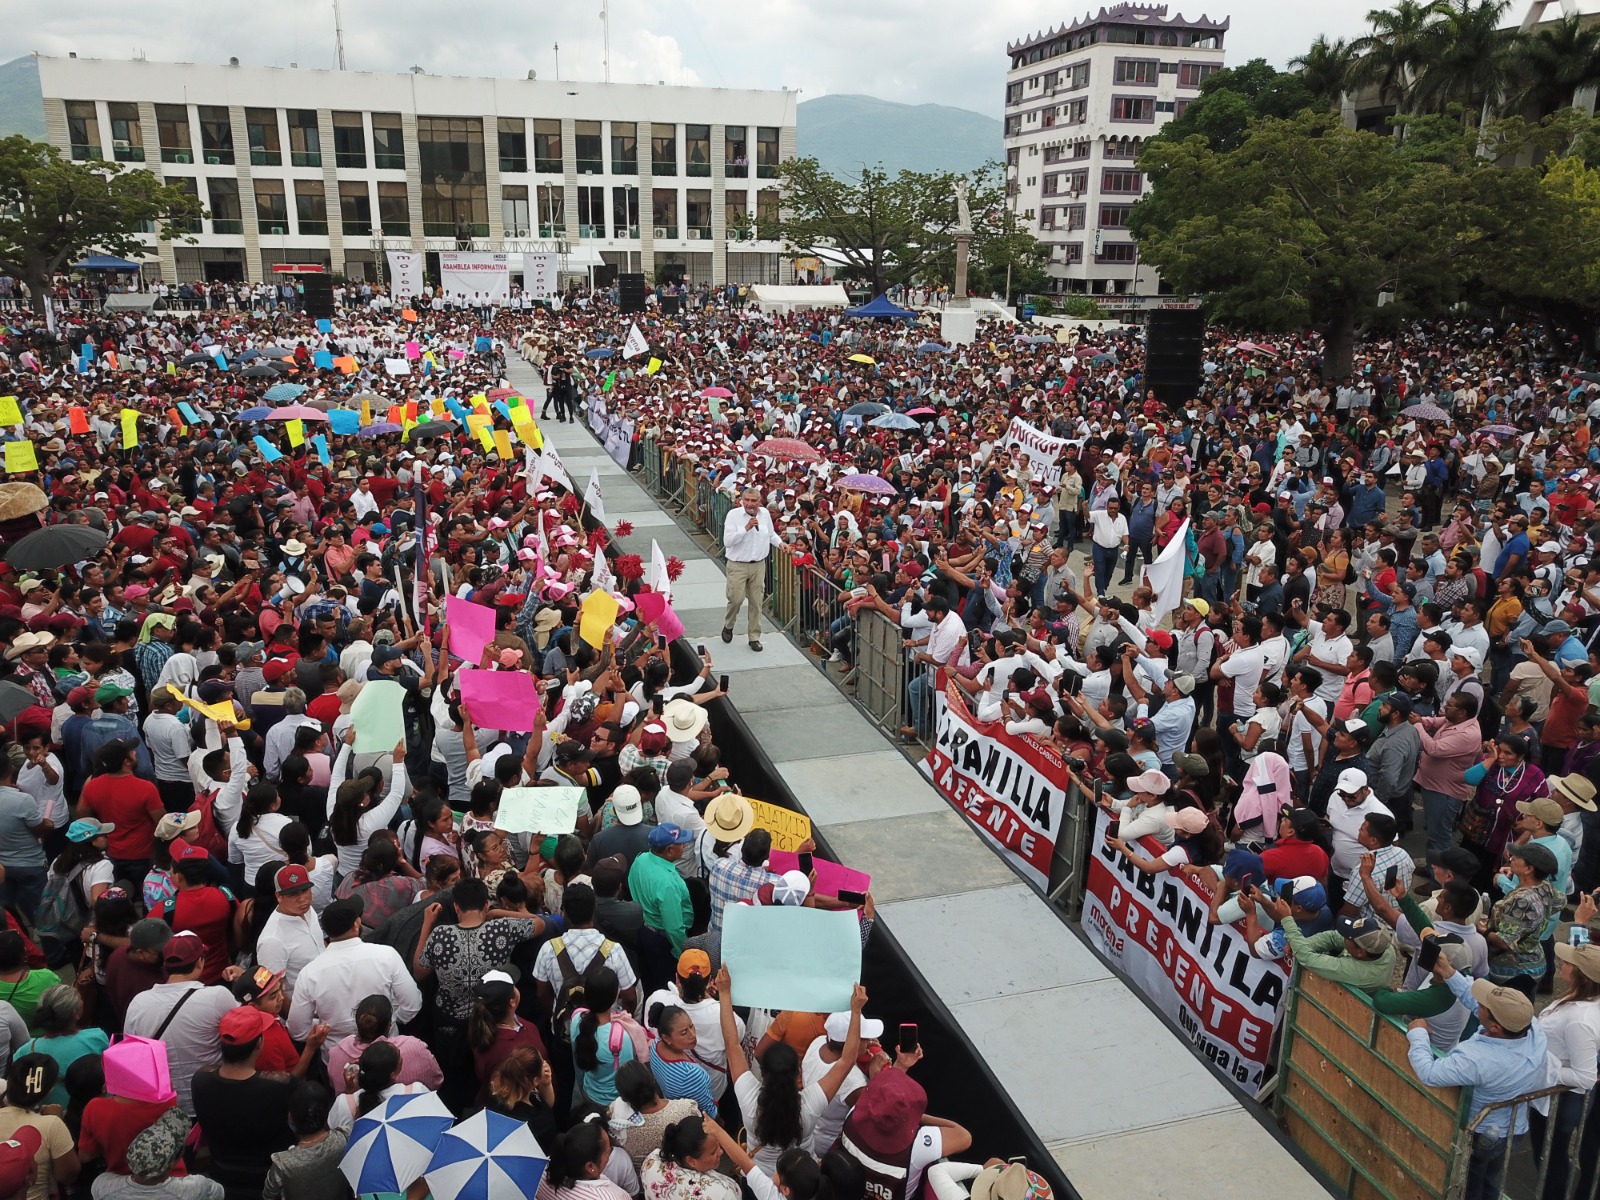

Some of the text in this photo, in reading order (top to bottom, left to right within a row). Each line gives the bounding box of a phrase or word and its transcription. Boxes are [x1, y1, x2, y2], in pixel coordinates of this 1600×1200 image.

[396, 255, 411, 300] morena
[533, 255, 547, 298] morena
[1039, 746, 1062, 769] CABELLO
[1090, 904, 1125, 953] morena
[1109, 885, 1260, 1054] PRESENTE
[1178, 1004, 1199, 1042] Que
[1193, 1033, 1230, 1071] siga
[1231, 1056, 1249, 1084] la
